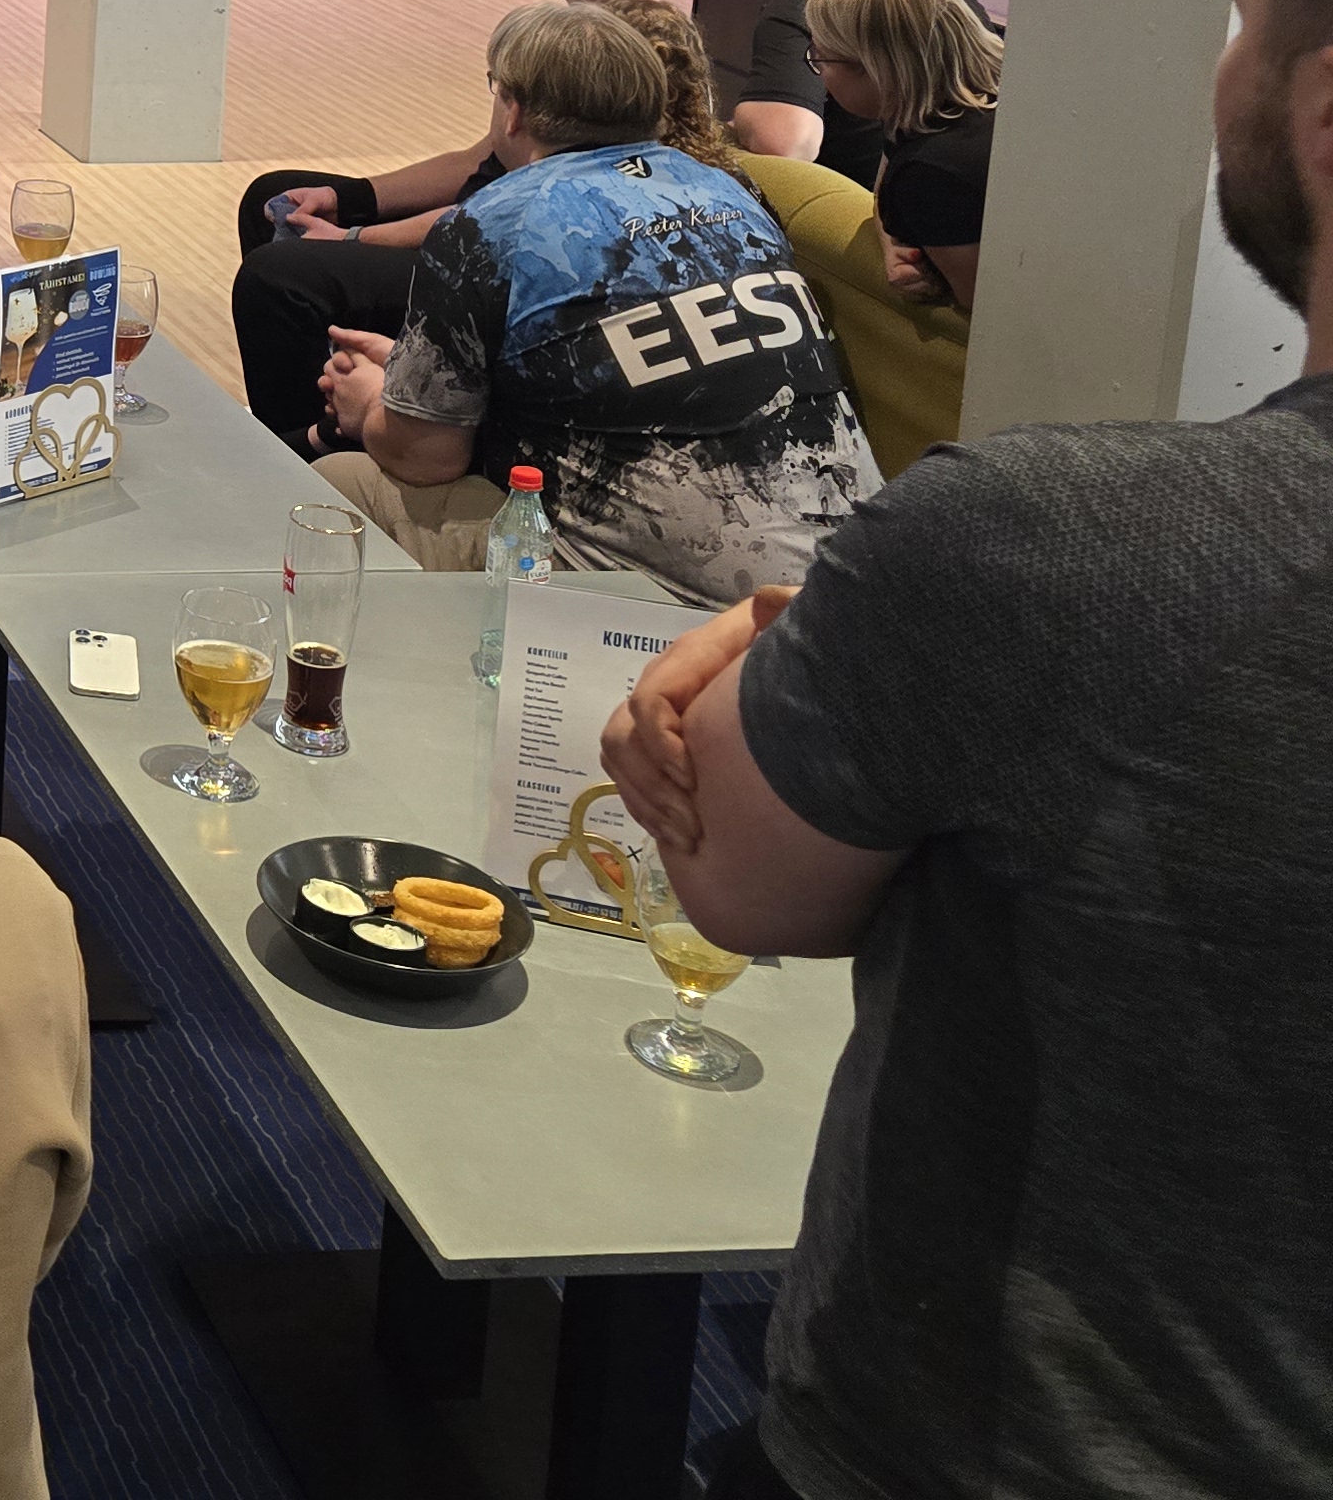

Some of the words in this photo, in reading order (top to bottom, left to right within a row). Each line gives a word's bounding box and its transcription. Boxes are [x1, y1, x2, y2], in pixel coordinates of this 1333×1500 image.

[624, 217, 683, 241] Peeter
[597, 270, 836, 388] EEST
[603, 630, 674, 654] KOKTEILI
